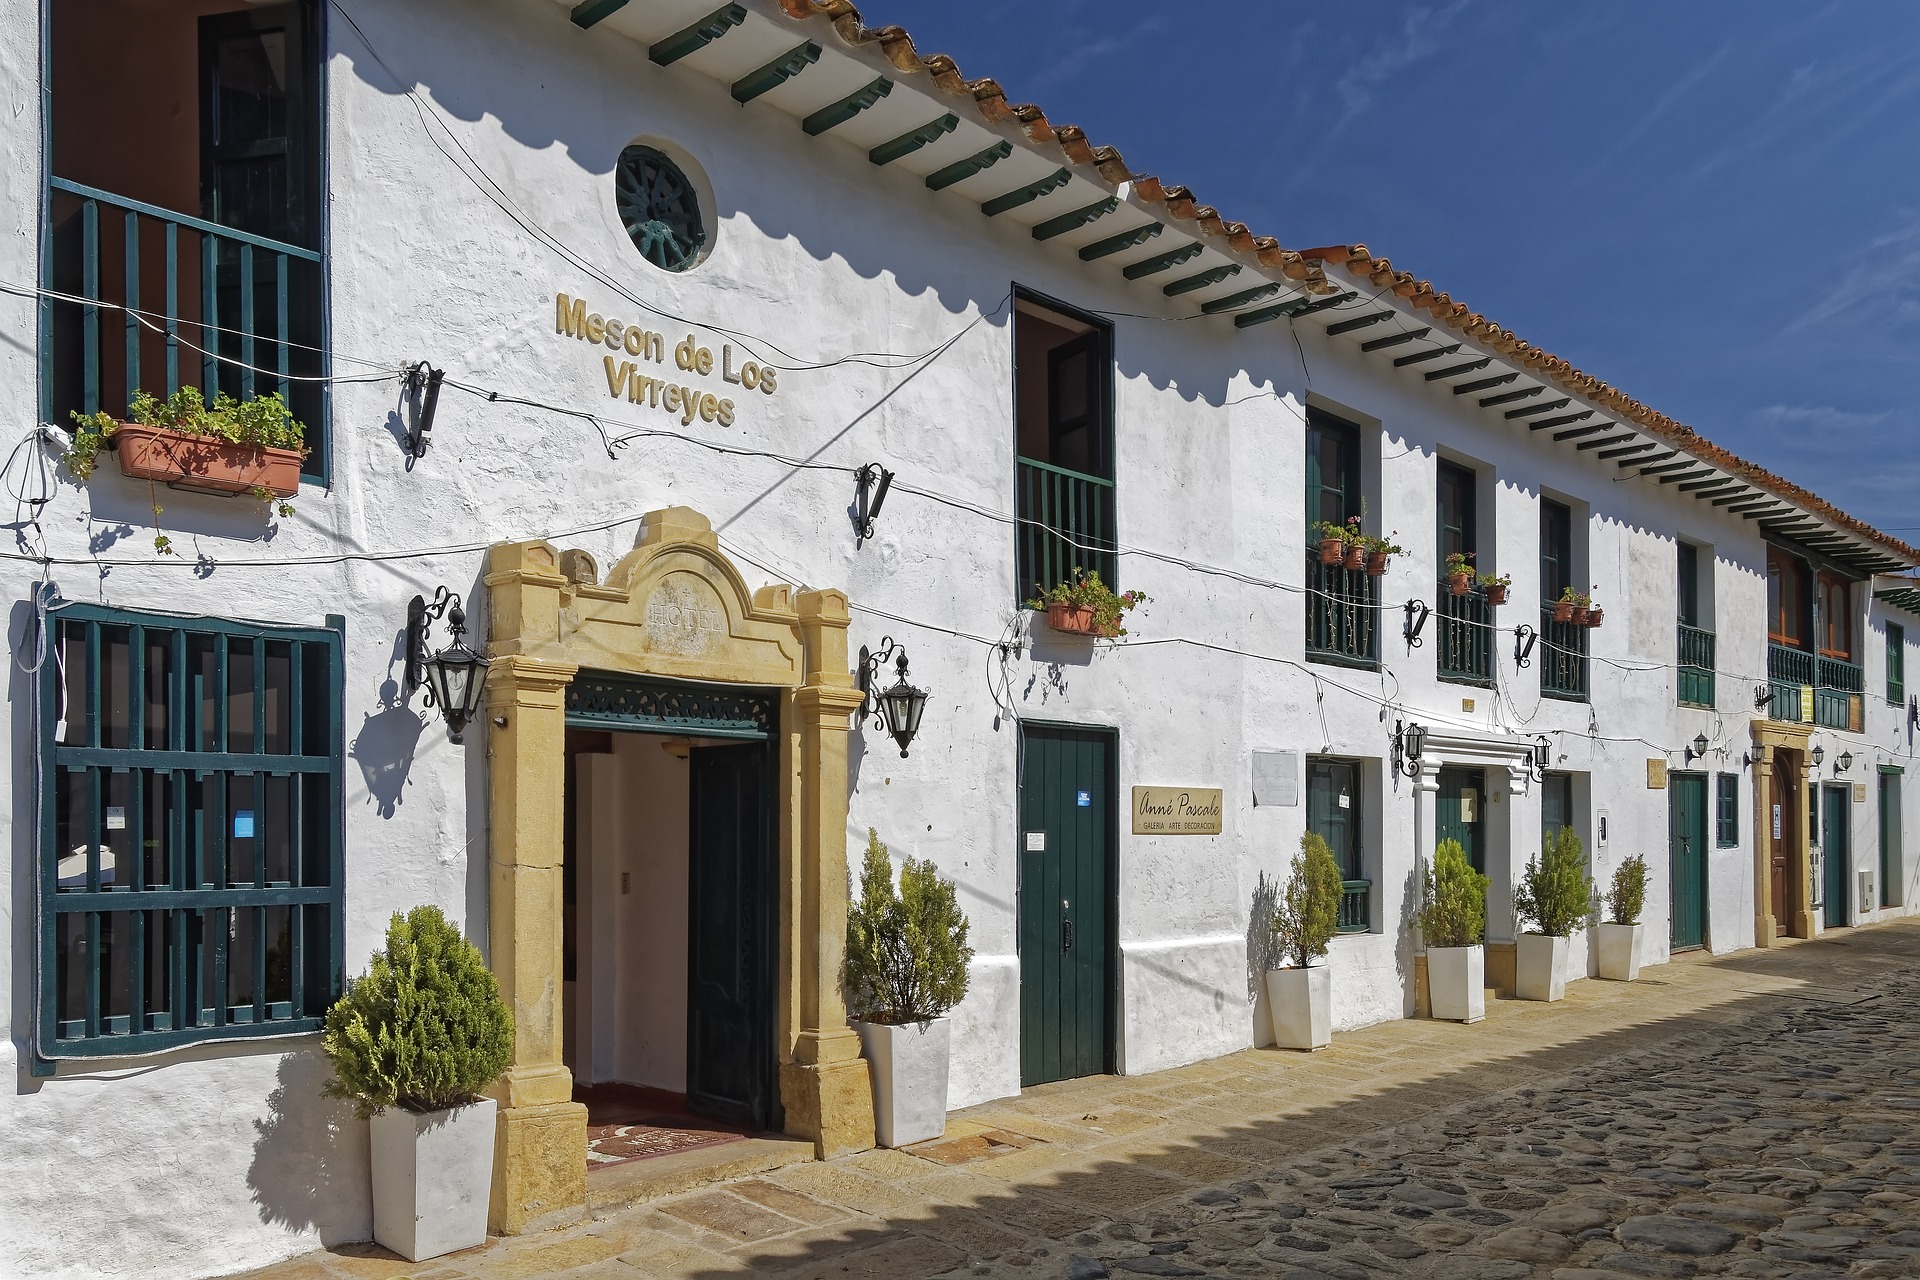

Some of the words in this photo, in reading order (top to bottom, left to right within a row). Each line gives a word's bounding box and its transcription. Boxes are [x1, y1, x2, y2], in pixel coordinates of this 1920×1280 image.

[555, 292, 665, 364] Meson
[674, 333, 714, 377] de
[722, 343, 778, 395] Los
[603, 355, 736, 427] Virreyes
[650, 603, 723, 632] HOTEL
[1139, 791, 1174, 816] Anné
[1177, 792, 1220, 817] Pascale
[1143, 822, 1165, 830] GALERIA
[1168, 822, 1181, 830] ARTE
